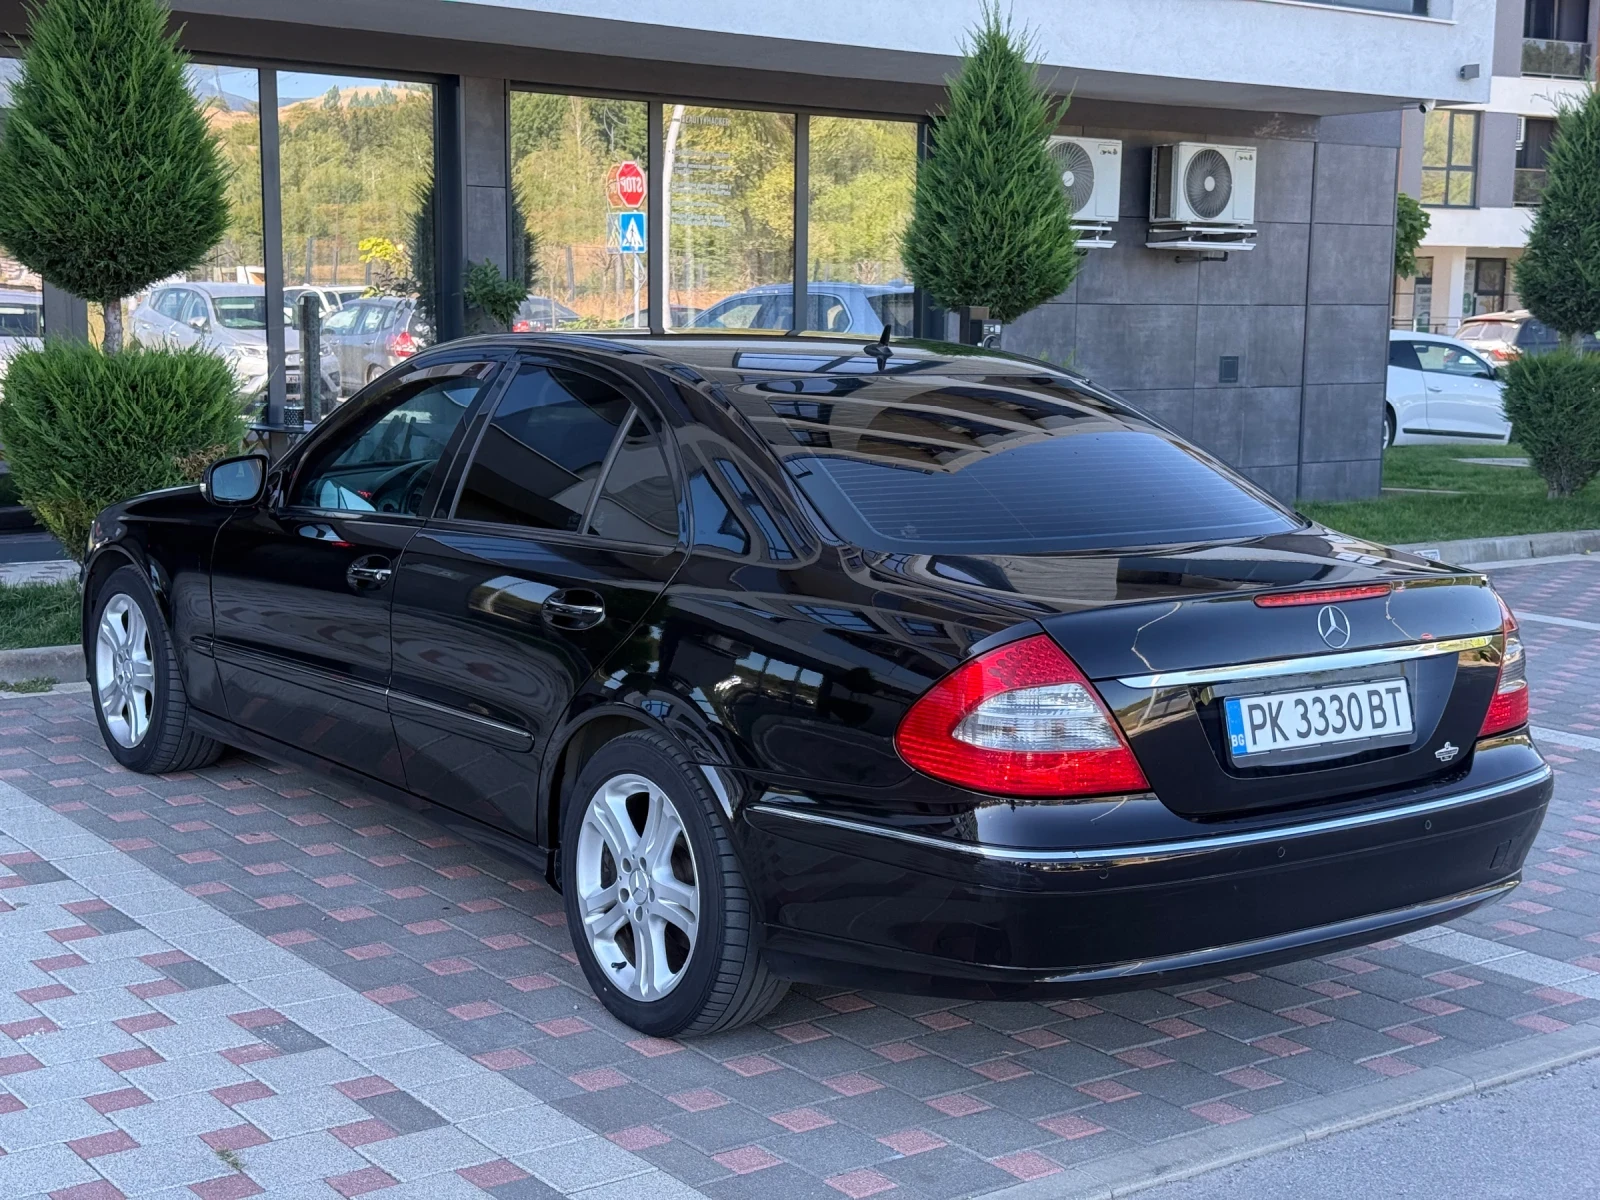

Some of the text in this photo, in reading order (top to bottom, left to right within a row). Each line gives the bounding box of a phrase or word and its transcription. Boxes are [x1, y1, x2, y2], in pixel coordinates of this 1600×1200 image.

[1247, 687, 1402, 746] PK 3330 BT
[1231, 734, 1245, 747] BG
